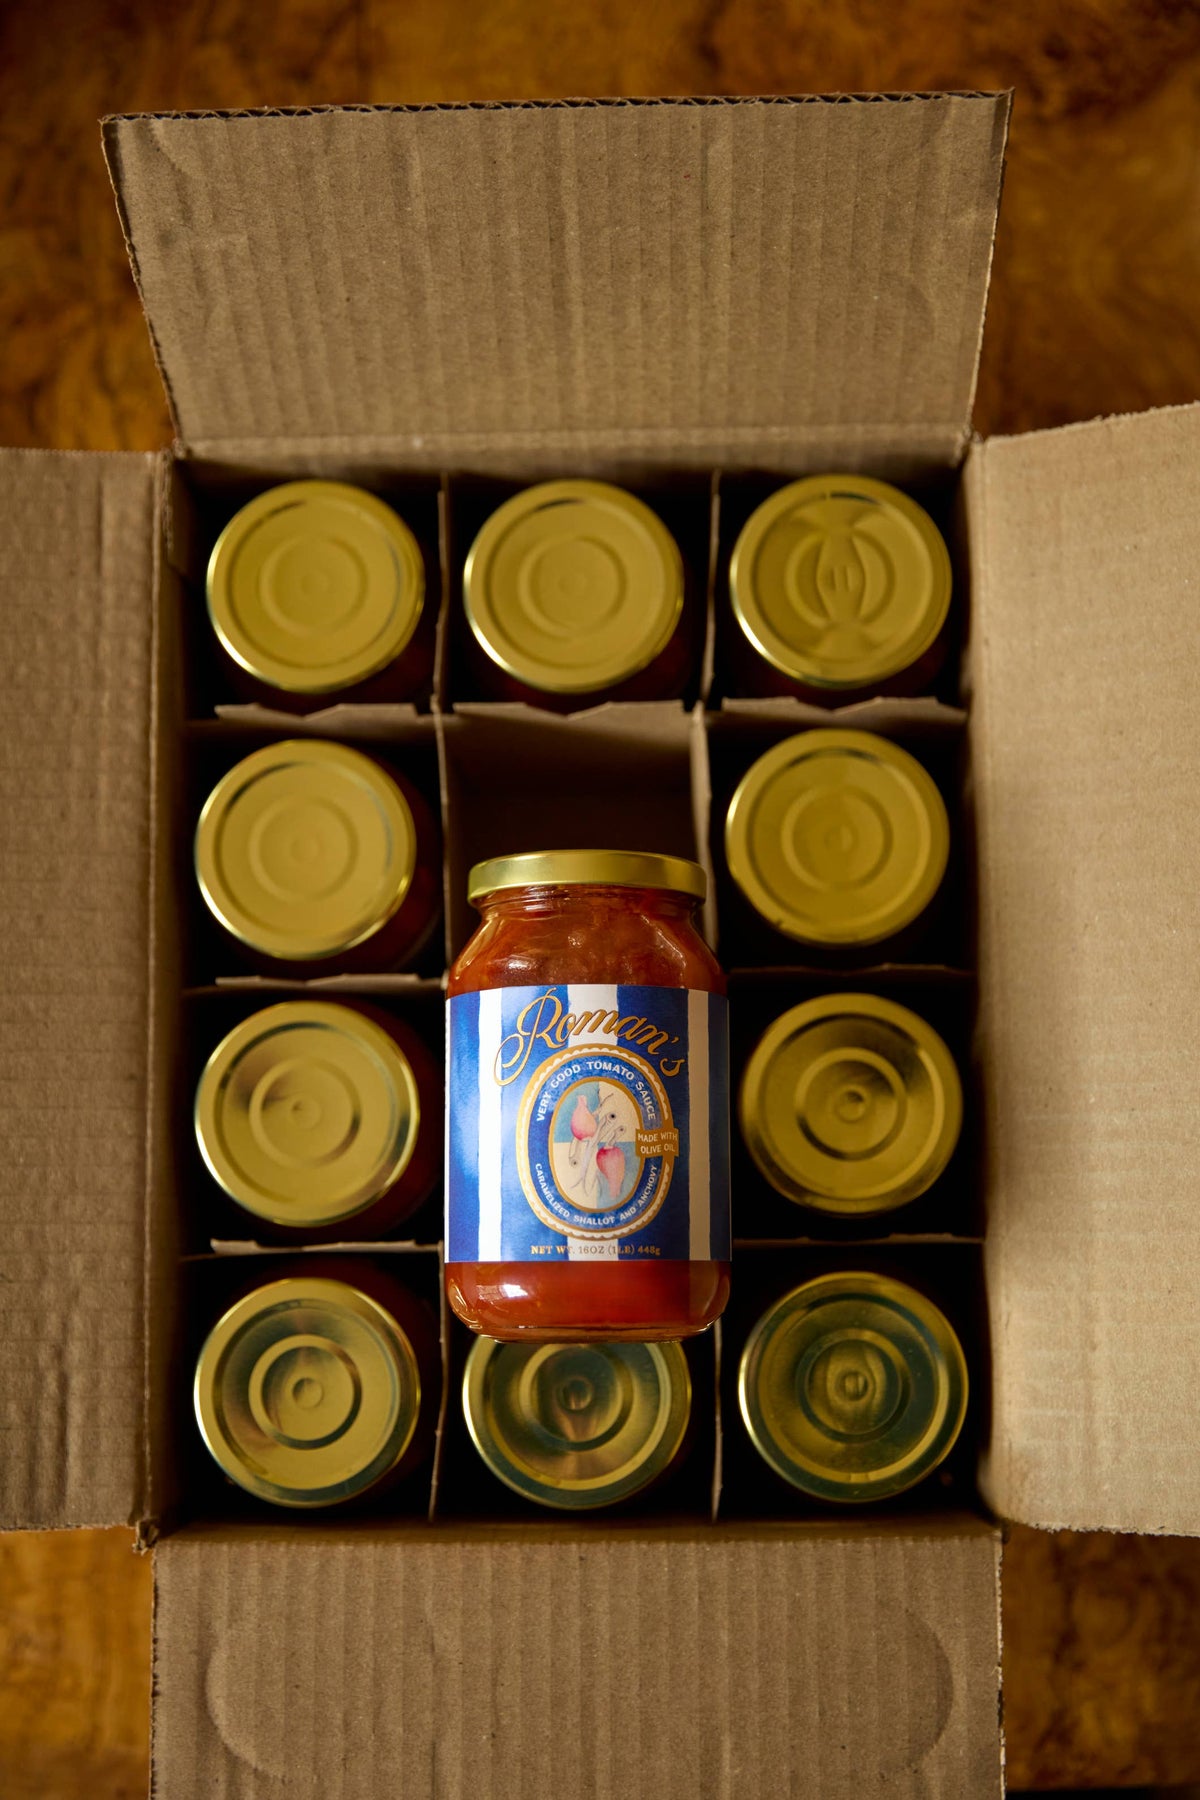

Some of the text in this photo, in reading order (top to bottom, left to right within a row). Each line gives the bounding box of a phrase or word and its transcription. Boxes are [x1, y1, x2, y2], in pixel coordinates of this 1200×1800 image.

[493, 987, 686, 1086] Roman's
[536, 1061, 656, 1122] VERY GOOD TOMATO SAUCE
[637, 1131, 678, 1143] MADE WITH
[640, 1143, 676, 1155] OLIVE OIL
[535, 1163, 658, 1225] CARAMELIZED SHALLOT AND ANCHOVY
[530, 1244, 661, 1256] NET WT. 16OZ (1LB) 448g
